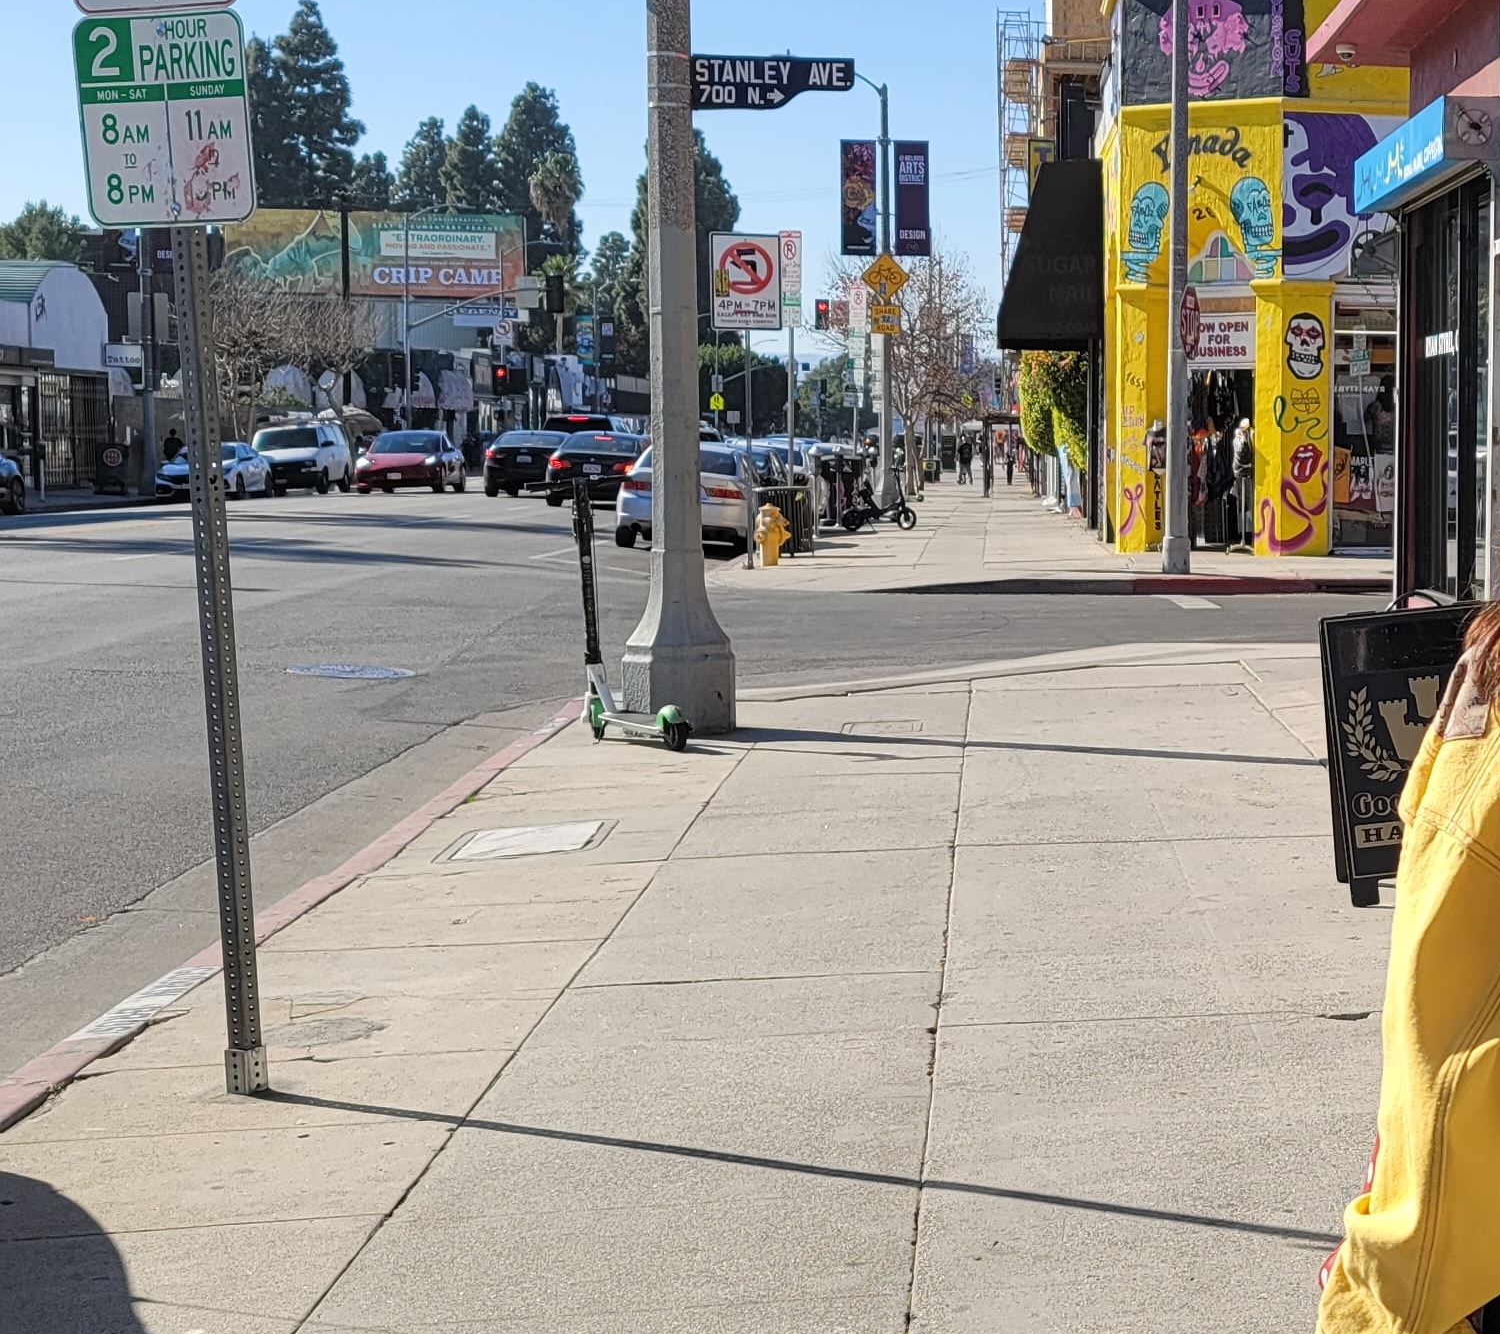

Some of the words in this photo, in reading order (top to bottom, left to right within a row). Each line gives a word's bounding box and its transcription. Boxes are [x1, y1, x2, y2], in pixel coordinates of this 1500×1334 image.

[88, 26, 121, 77] 2
[164, 18, 207, 41] HOUR
[138, 38, 236, 82] PARKING
[695, 58, 791, 85] STANLEY
[808, 61, 852, 87] AVE.
[190, 84, 225, 97] SUNDAY
[699, 84, 736, 105] 700
[747, 85, 766, 105] N.
[124, 153, 138, 166] TO
[899, 162, 925, 174] ARTS
[899, 174, 924, 182] DISTRICT
[900, 230, 926, 239] DESIGN
[373, 267, 433, 284] CRIP
[438, 268, 501, 285] CAMP
[1181, 309, 1200, 335] STOP
[1198, 322, 1215, 333] OW
[1219, 321, 1249, 333] OPEN
[1207, 334, 1231, 345] FOR
[107, 355, 142, 365] Tattoo
